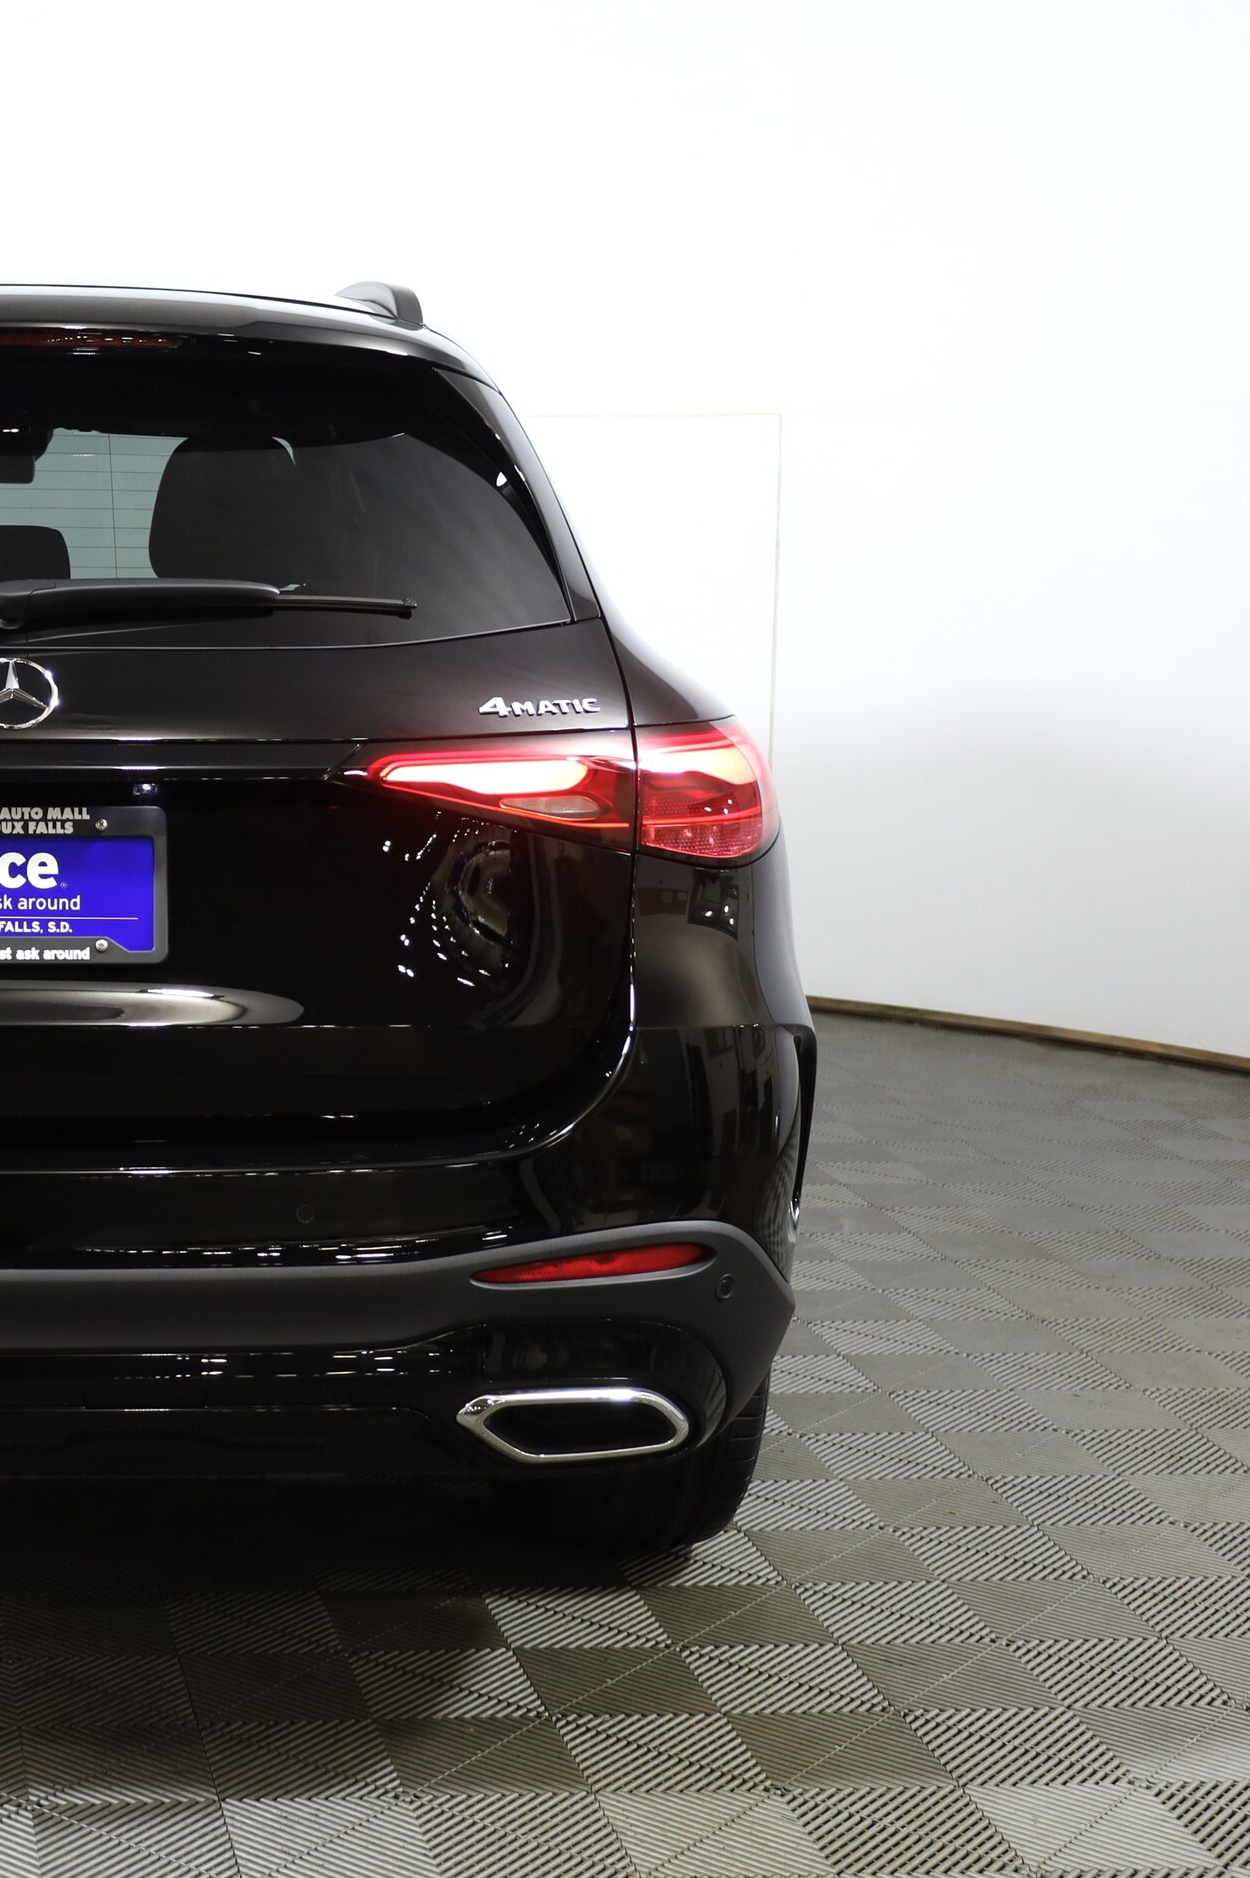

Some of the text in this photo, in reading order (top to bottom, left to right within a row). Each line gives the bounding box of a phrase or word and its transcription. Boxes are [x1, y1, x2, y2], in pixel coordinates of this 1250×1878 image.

[478, 697, 601, 717] 4MATIC
[0, 807, 43, 820] AUTO
[47, 807, 90, 820] MALL
[28, 821, 74, 834] FALLS
[18, 895, 81, 911] around
[48, 921, 73, 933] S.D.
[16, 946, 40, 960] ask
[43, 946, 90, 961] around
